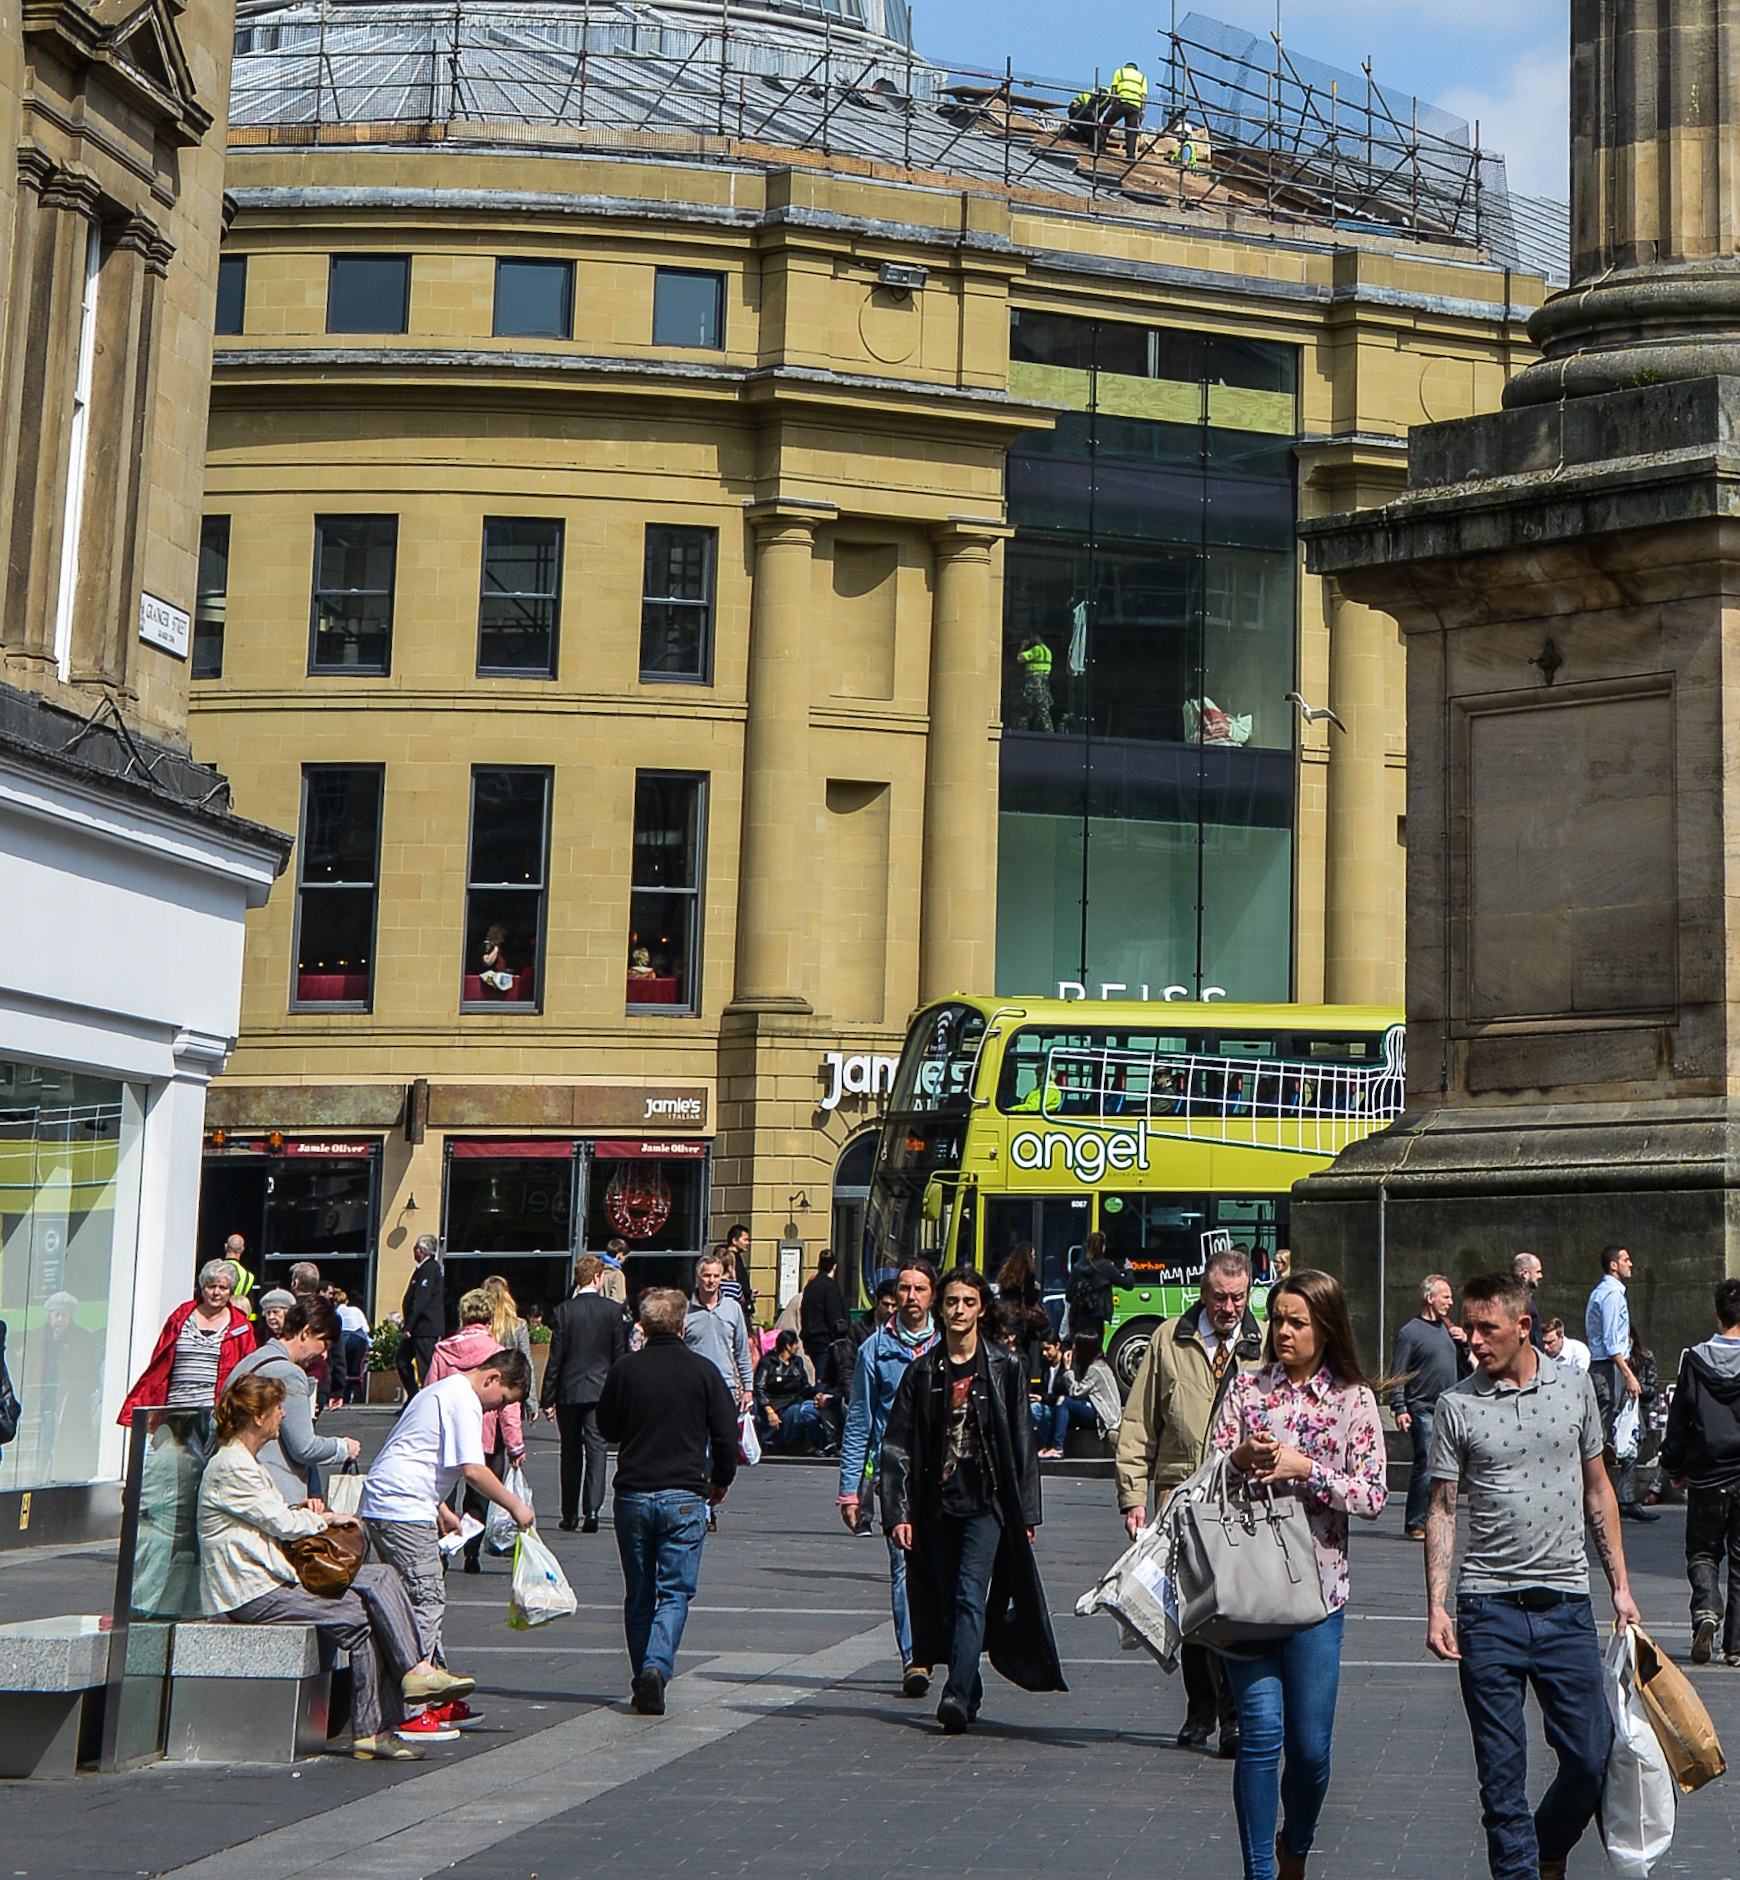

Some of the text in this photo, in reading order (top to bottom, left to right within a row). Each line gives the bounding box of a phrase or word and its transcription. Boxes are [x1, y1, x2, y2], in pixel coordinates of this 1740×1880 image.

[297, 1143, 365, 1153] Jamie Oliver
[641, 1143, 700, 1154] Jamie Oliver
[1011, 1119, 1151, 1184] angel
